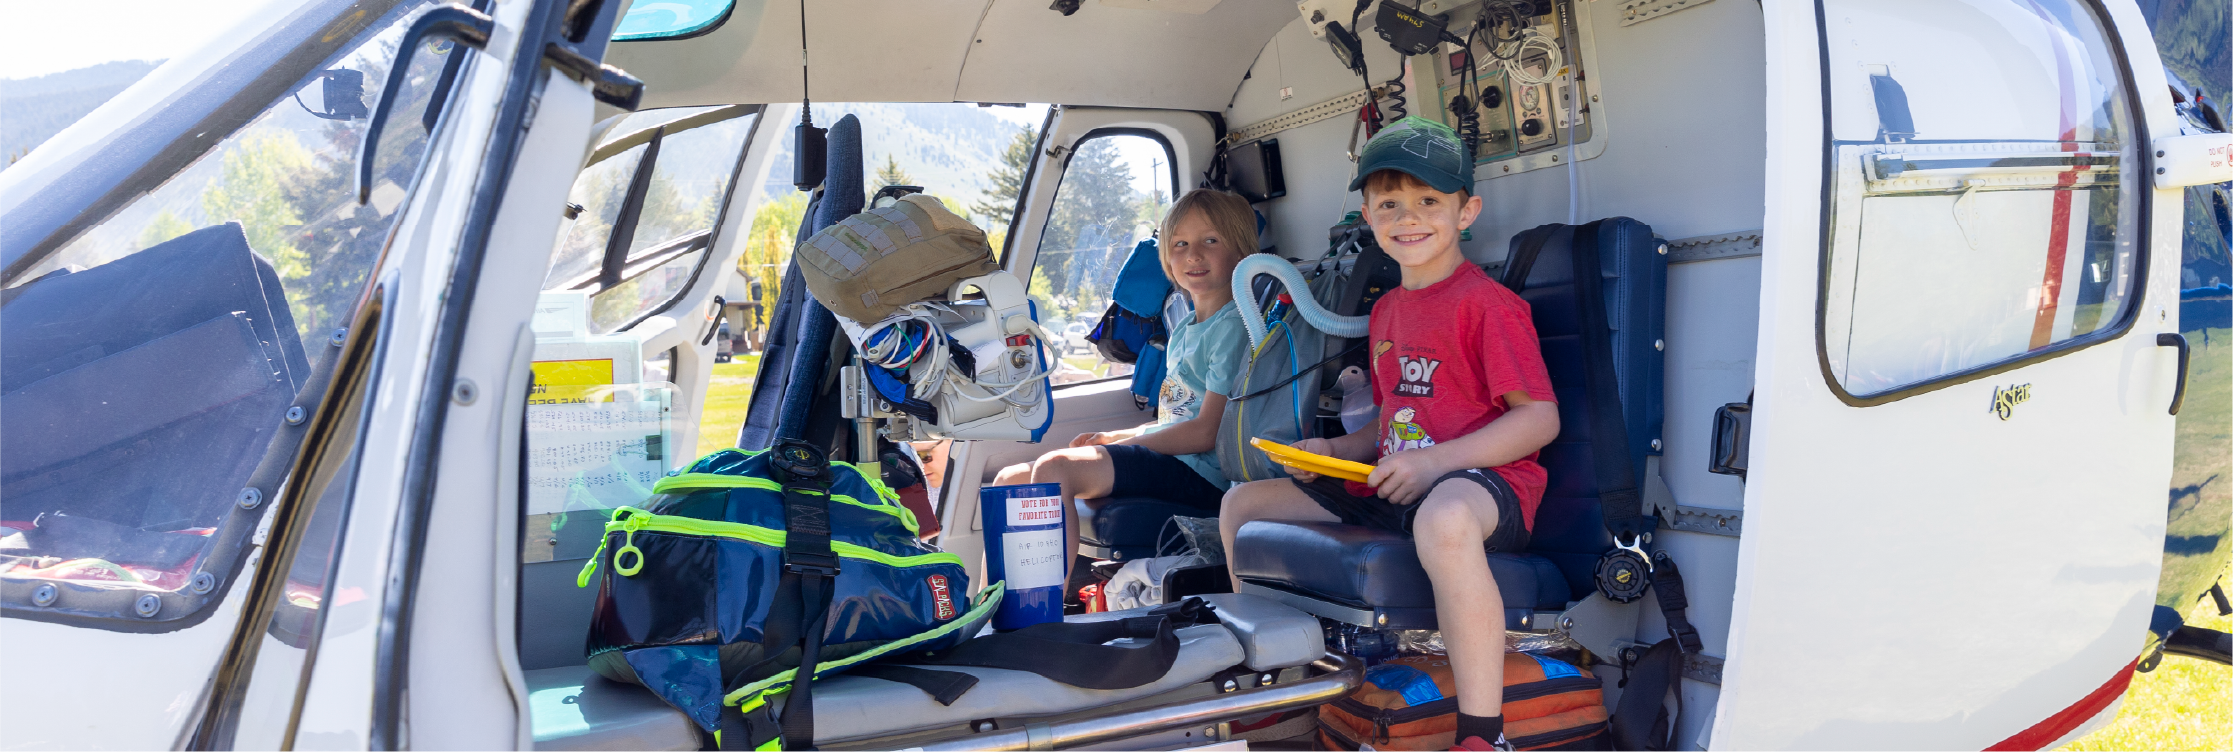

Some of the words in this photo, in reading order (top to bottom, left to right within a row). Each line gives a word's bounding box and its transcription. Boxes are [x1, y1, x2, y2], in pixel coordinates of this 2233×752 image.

[1398, 355, 1441, 383] TOY
[1021, 499, 1037, 508] VOTE
[1039, 499, 1049, 508] FOR
[1018, 511, 1048, 520] FAVORITE
